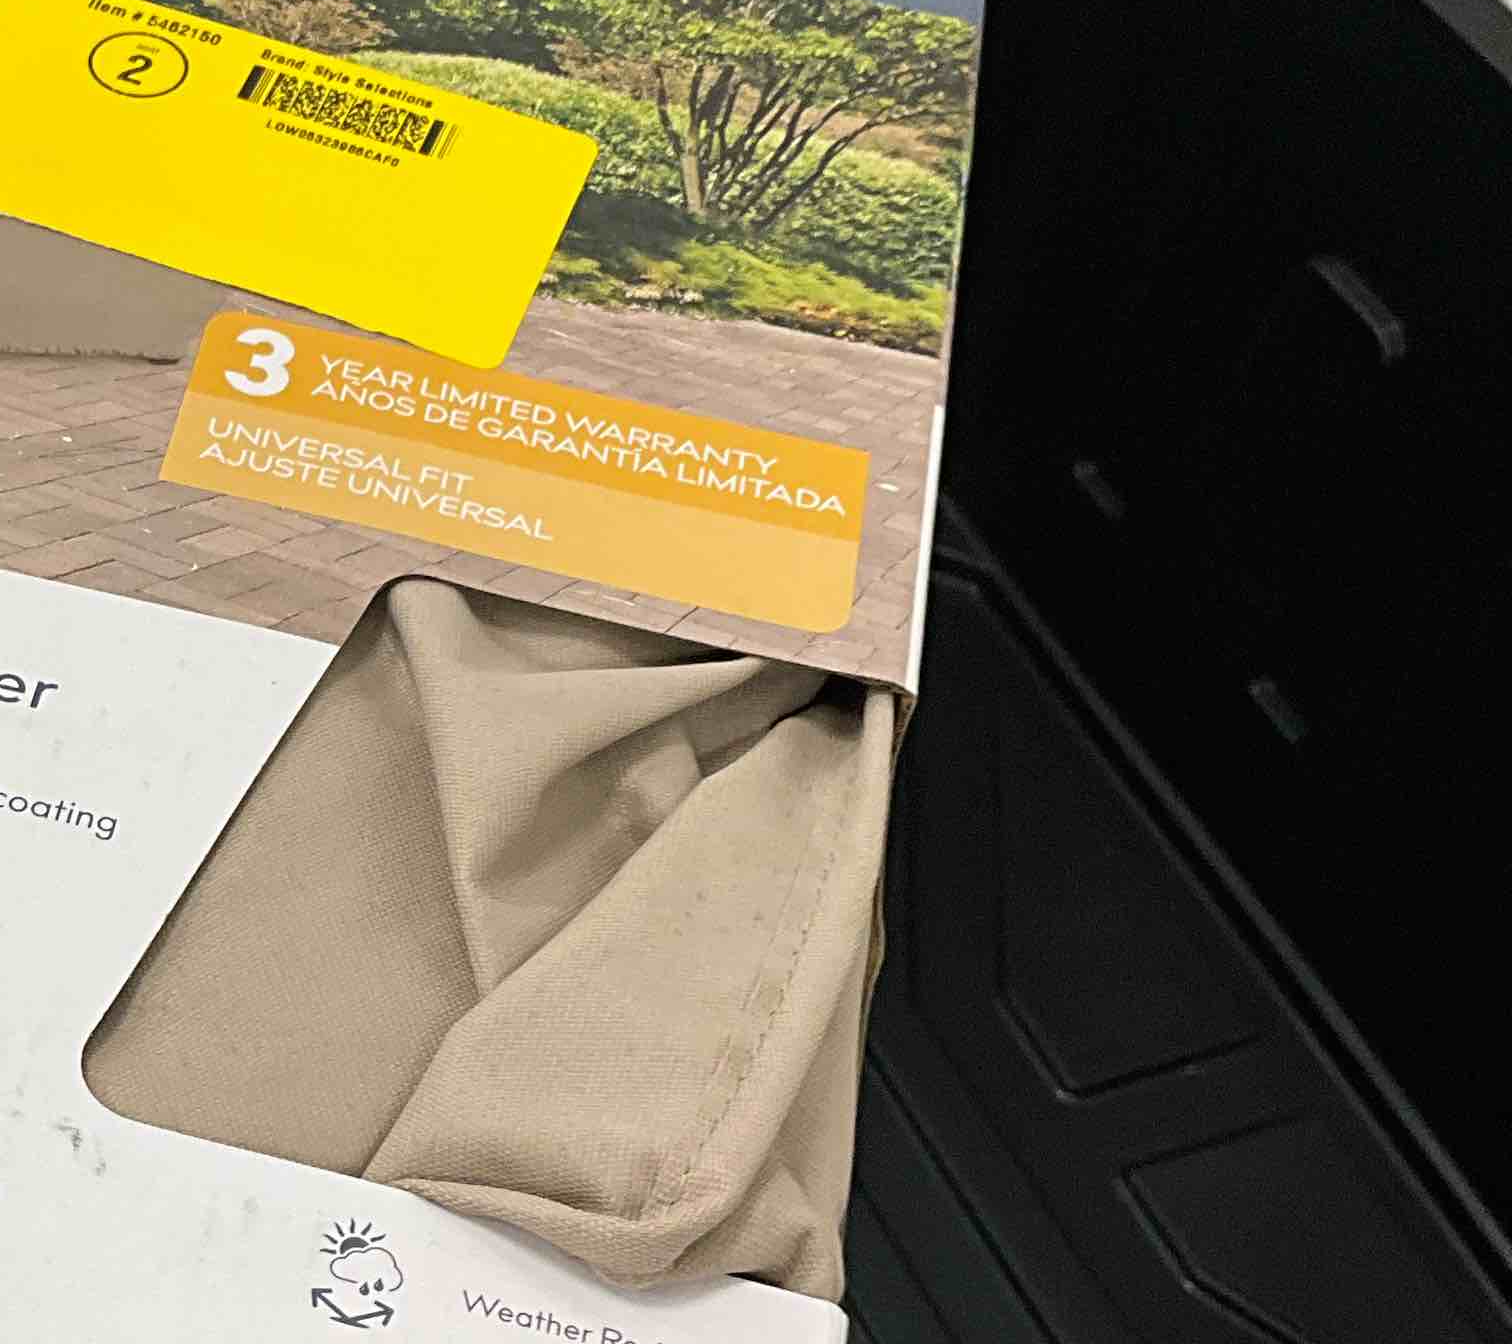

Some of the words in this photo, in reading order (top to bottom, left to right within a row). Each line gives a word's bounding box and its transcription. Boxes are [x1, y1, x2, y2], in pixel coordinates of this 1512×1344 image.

[146, 14, 223, 47] 5462150
[117, 55, 154, 85] 2
[259, 48, 309, 72] Brand:
[313, 63, 352, 86] Style
[354, 76, 434, 109] Selections
[223, 327, 296, 396] 3
[311, 378, 417, 417] AÑOS
[423, 401, 471, 432] DE
[476, 416, 669, 479] GARANTÍA
[675, 462, 846, 517] LIMITADA
[321, 354, 415, 394] YEAR
[419, 375, 558, 425] LIMITED
[565, 411, 778, 475] WARRANTY
[207, 415, 412, 484] UNIVERSAL
[418, 463, 475, 497] FIT
[198, 441, 344, 492] AJUSTE
[346, 474, 556, 544] UNIVERSAL
[461, 1288, 595, 1344] Weather
